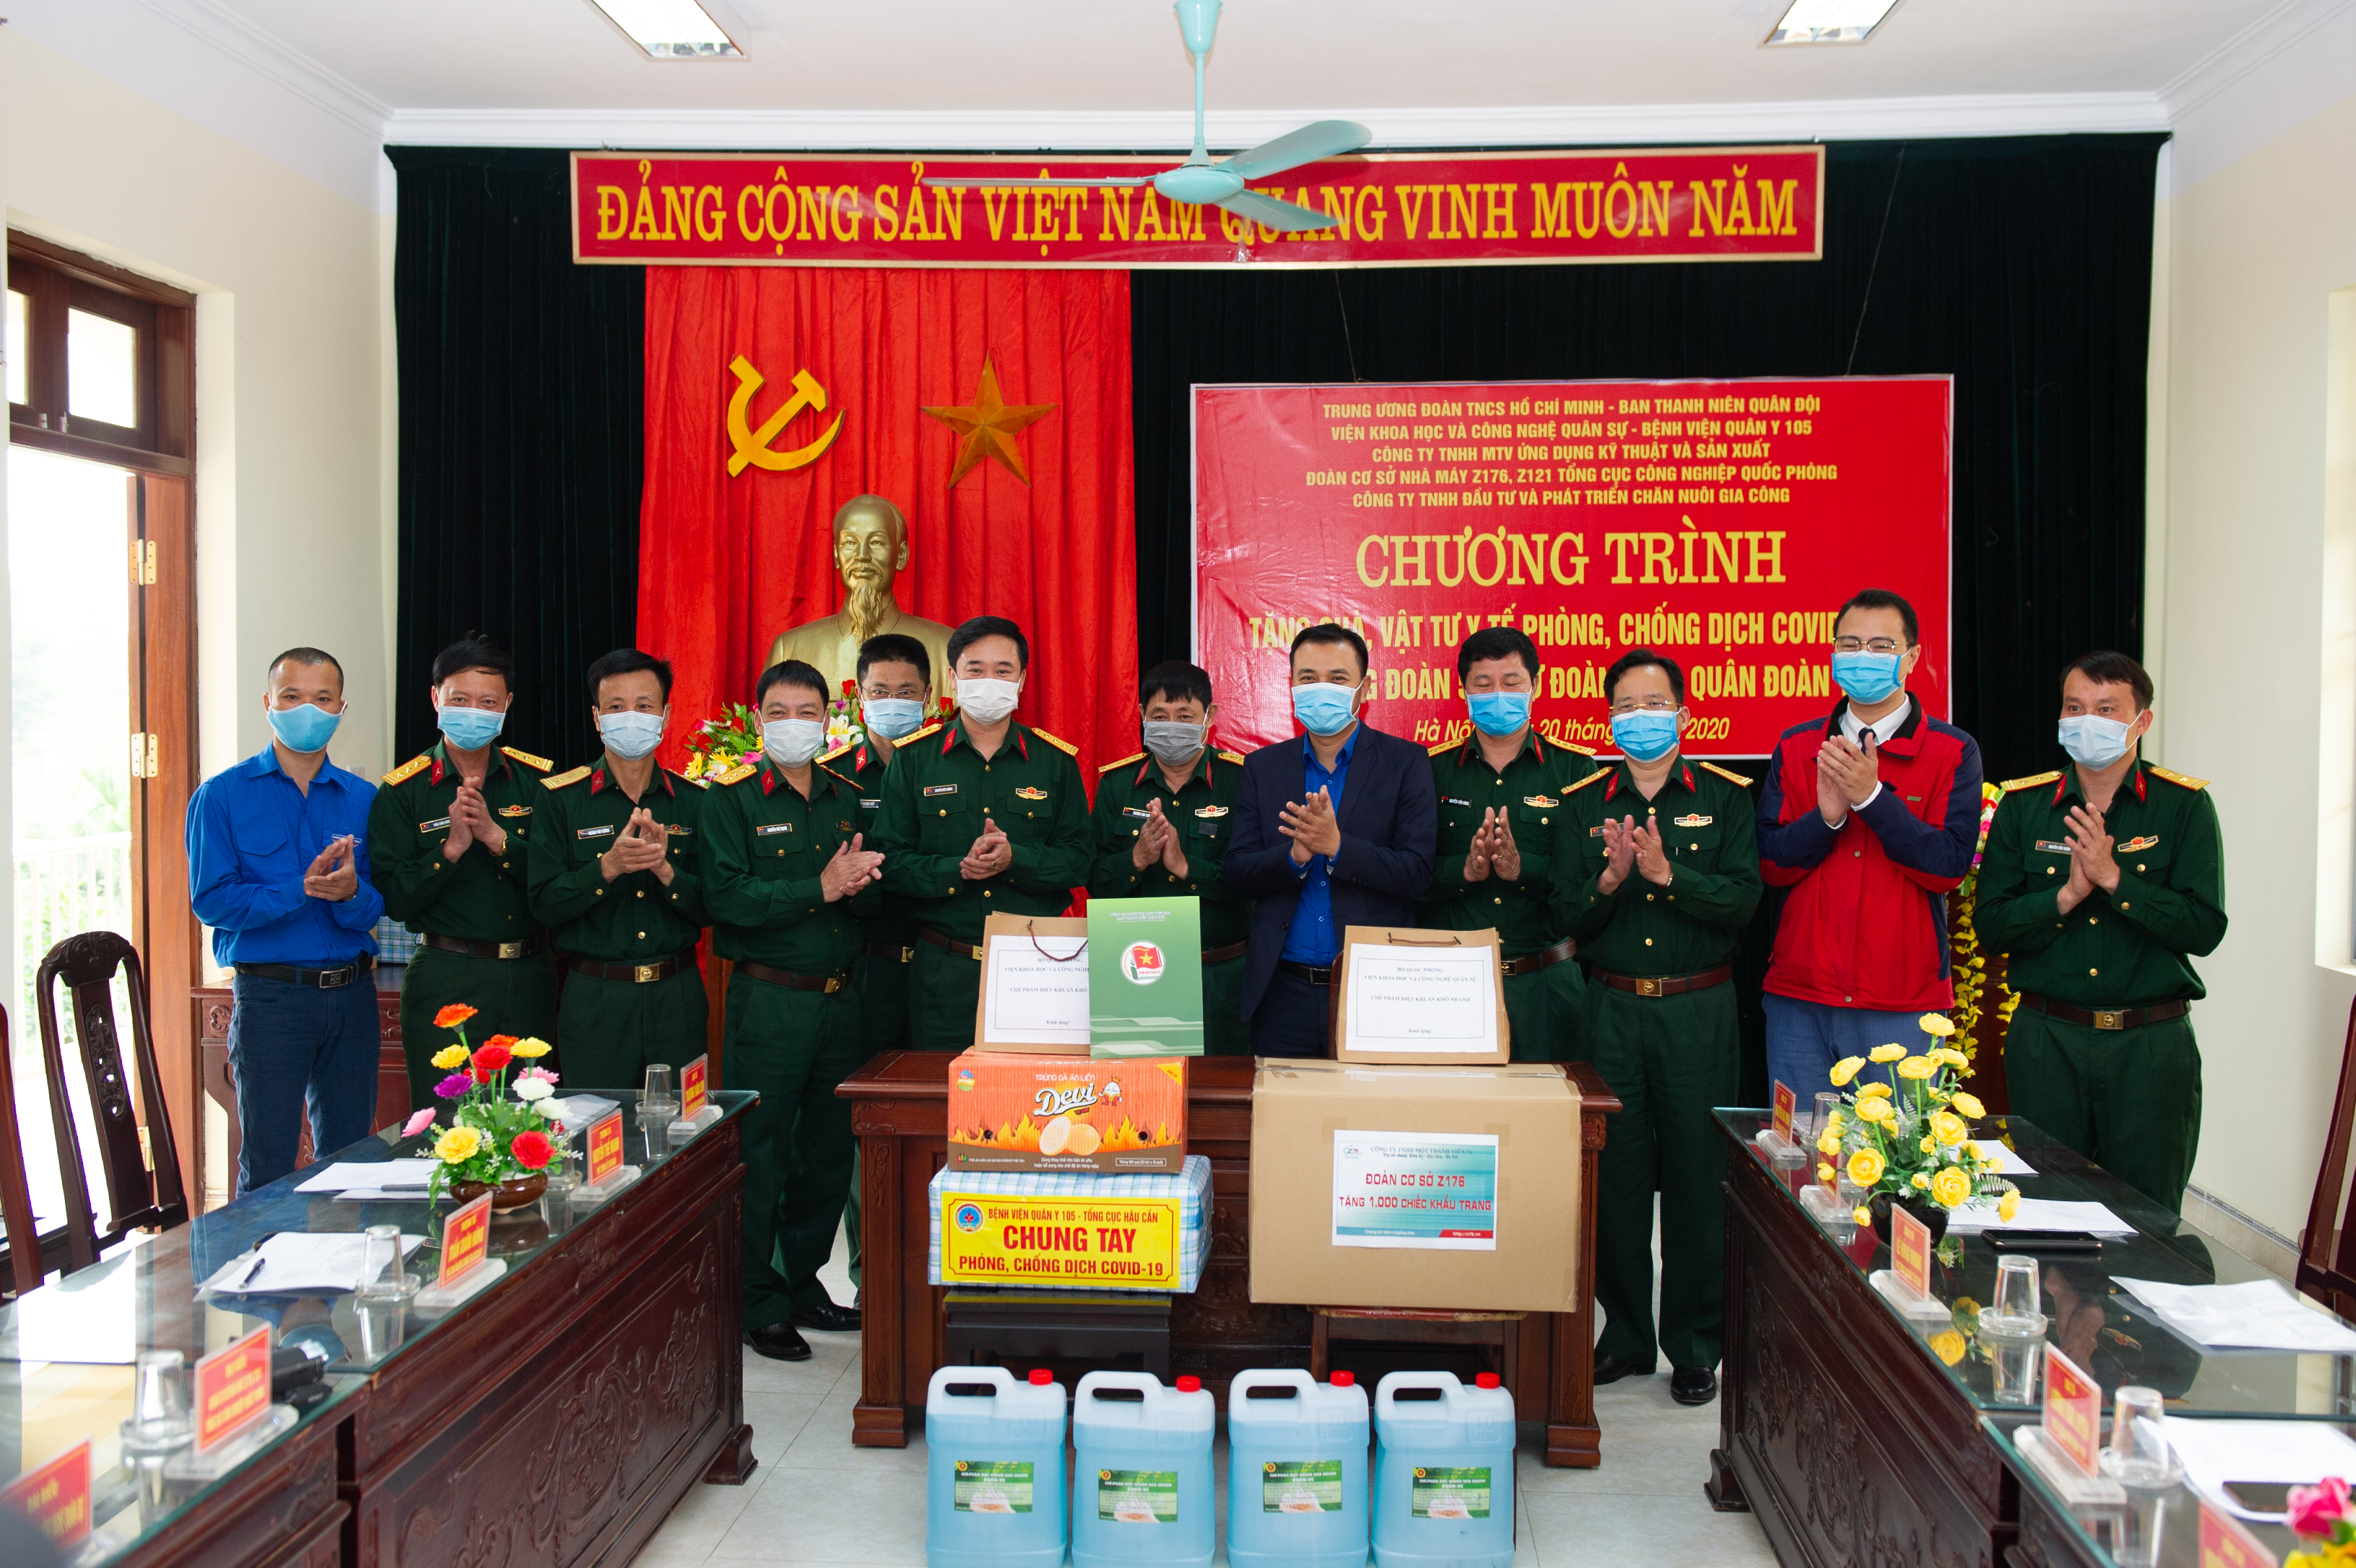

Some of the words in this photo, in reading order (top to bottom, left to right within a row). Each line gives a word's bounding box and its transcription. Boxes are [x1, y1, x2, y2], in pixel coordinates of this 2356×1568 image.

[597, 159, 726, 241] ĐẢNG
[738, 166, 863, 256] CỘNG
[874, 160, 963, 241] SẢN
[980, 168, 1087, 256] VIỆT
[1098, 187, 1206, 241] NAM
[1396, 183, 1518, 239] VINH
[1531, 162, 1674, 239] MUÔN
[1689, 164, 1798, 237] NĂM
[1322, 403, 1372, 418] TRUNG
[1375, 400, 1417, 417] ƯƠNG
[1420, 399, 1463, 417] ĐOÀN
[1466, 401, 1506, 417] TNCS
[1509, 396, 1530, 416] HỒ
[1534, 397, 1559, 416] CHÍ
[1563, 400, 1604, 415] MINH
[1618, 399, 1650, 414] BAN
[1654, 398, 1704, 414] THANH
[1708, 395, 1745, 414] NIÊN
[1748, 394, 1791, 414] QUÂN
[1794, 394, 1820, 416] ĐỘI
[1331, 423, 1365, 443] VIỆN
[1369, 425, 1409, 440] KHOA
[1413, 425, 1444, 442] HỌC
[1448, 421, 1467, 439] VÀ
[1471, 421, 1513, 439] CÔNG
[1517, 420, 1557, 441] NGHỆ
[1561, 419, 1603, 440] QUÂN
[1606, 420, 1629, 440] SỰ
[1641, 418, 1682, 440] BỆNH
[1686, 418, 1721, 440] VIỆN
[1724, 417, 1767, 440] QUÂN
[1770, 419, 1780, 436] Y
[1785, 419, 1813, 435] 105
[1372, 445, 1413, 464] CÔNG
[1417, 447, 1434, 462] TY
[1439, 447, 1478, 462] TNHH
[1482, 446, 1513, 462] MTV
[1517, 442, 1548, 461] ỨNG
[1552, 445, 1594, 462] DỤNG
[1598, 442, 1618, 460] KỸ
[1621, 441, 1668, 462] THUẬT
[1672, 440, 1693, 459] VÀ
[1696, 438, 1728, 459] SẢN
[1731, 438, 1771, 458] XUẤT
[1306, 469, 1347, 486] ĐOÀN
[1351, 469, 1372, 486] CƠ
[1375, 465, 1396, 485] SỞ
[1400, 467, 1431, 484] NHÀ
[1435, 467, 1468, 484] MÁY
[1472, 469, 1513, 485] Z176,
[1517, 468, 1552, 483] Z121
[1557, 462, 1597, 483] TỔNG
[1601, 467, 1631, 484] CỤC
[1635, 464, 1677, 482] CÔNG
[1681, 462, 1737, 484] NGHIỆP
[1741, 460, 1781, 482] QUỐC
[1785, 462, 1838, 480] PHÒNG
[1352, 491, 1394, 508] CÔNG
[1398, 493, 1415, 508] TY
[1419, 492, 1458, 507] TNHH
[1461, 487, 1493, 506] ĐẦU
[1496, 490, 1517, 506] TƯ
[1519, 488, 1539, 506] VÀ
[1543, 487, 1581, 505] PHÁT
[1584, 484, 1628, 505] TRIỂN
[1632, 486, 1674, 504] CHĂN
[1678, 486, 1715, 504] NUÔI
[1718, 488, 1744, 504] GIA
[1748, 485, 1790, 503] CÔNG
[1356, 525, 1589, 588] CHƯƠNG
[1605, 515, 1786, 584] TRÌNH
[1380, 608, 1424, 654] VẬT
[1430, 612, 1463, 647] TƯ
[1522, 606, 1611, 649] PHÒNG,
[1618, 602, 1700, 646] CHỐNG
[1708, 612, 1765, 652] DỊCH
[1385, 661, 1450, 701] ĐOÀN
[1691, 658, 1756, 701] QUÂN
[1763, 658, 1830, 698] ĐOÀN
[1414, 717, 1441, 741] Hà
[1539, 718, 1561, 739] 20
[1564, 716, 1615, 746] tháng
[1685, 717, 1730, 740] 2020
[1167, 1068, 1178, 1078] NEW
[1033, 1082, 1098, 1116] Devi
[1365, 1170, 1396, 1186] ĐOÀN
[1401, 1174, 1415, 1186] CƠ
[1419, 1171, 1433, 1187] SỞ
[1437, 1175, 1465, 1188] Z176
[988, 1206, 1009, 1222] BỆNH
[1011, 1207, 1029, 1221] VIỆN
[1031, 1208, 1052, 1221] QUÂN
[1054, 1210, 1060, 1221] Y
[1062, 1210, 1076, 1221] 105
[1083, 1209, 1104, 1222] TỔNG
[1106, 1211, 1121, 1225] CỤC
[1124, 1210, 1139, 1225] HẬU
[1339, 1195, 1365, 1209] TẶNG
[1370, 1196, 1398, 1208] 1.000
[1401, 1194, 1427, 1210] CHIẾC
[1430, 1195, 1456, 1210] KHẨU
[1459, 1200, 1492, 1211] TRANG
[1003, 1225, 1087, 1252] CHUNG
[1096, 1228, 1137, 1253] TAY
[959, 1253, 1010, 1273] PHÒNG,
[1013, 1256, 1060, 1273] CHỐNG
[1065, 1260, 1097, 1276] DỊCH
[1101, 1260, 1163, 1276] COVID-19
